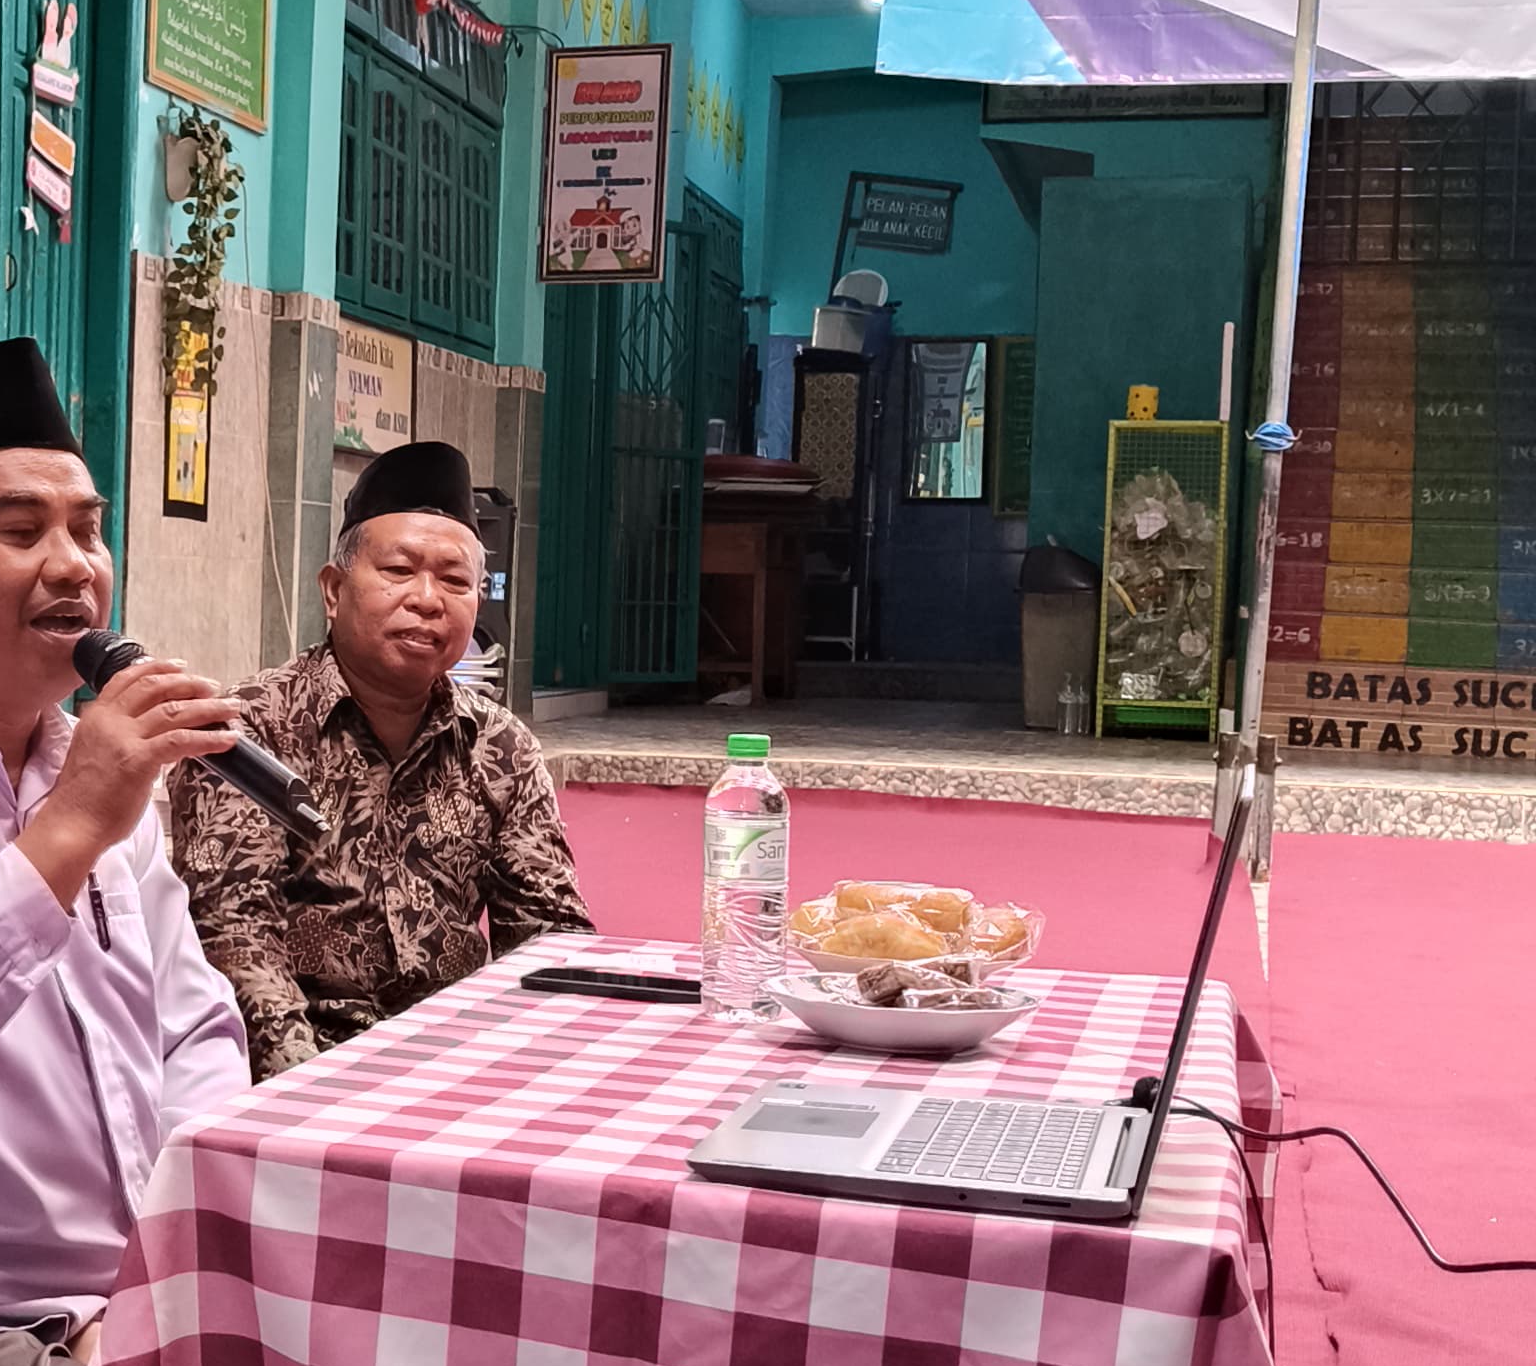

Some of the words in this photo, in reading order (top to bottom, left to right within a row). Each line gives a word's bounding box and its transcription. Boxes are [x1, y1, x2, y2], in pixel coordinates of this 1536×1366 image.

[882, 220, 911, 237] ANAK
[914, 224, 944, 241] KECIL
[1306, 671, 1432, 706] BATAS
[1451, 726, 1536, 758] SUC
